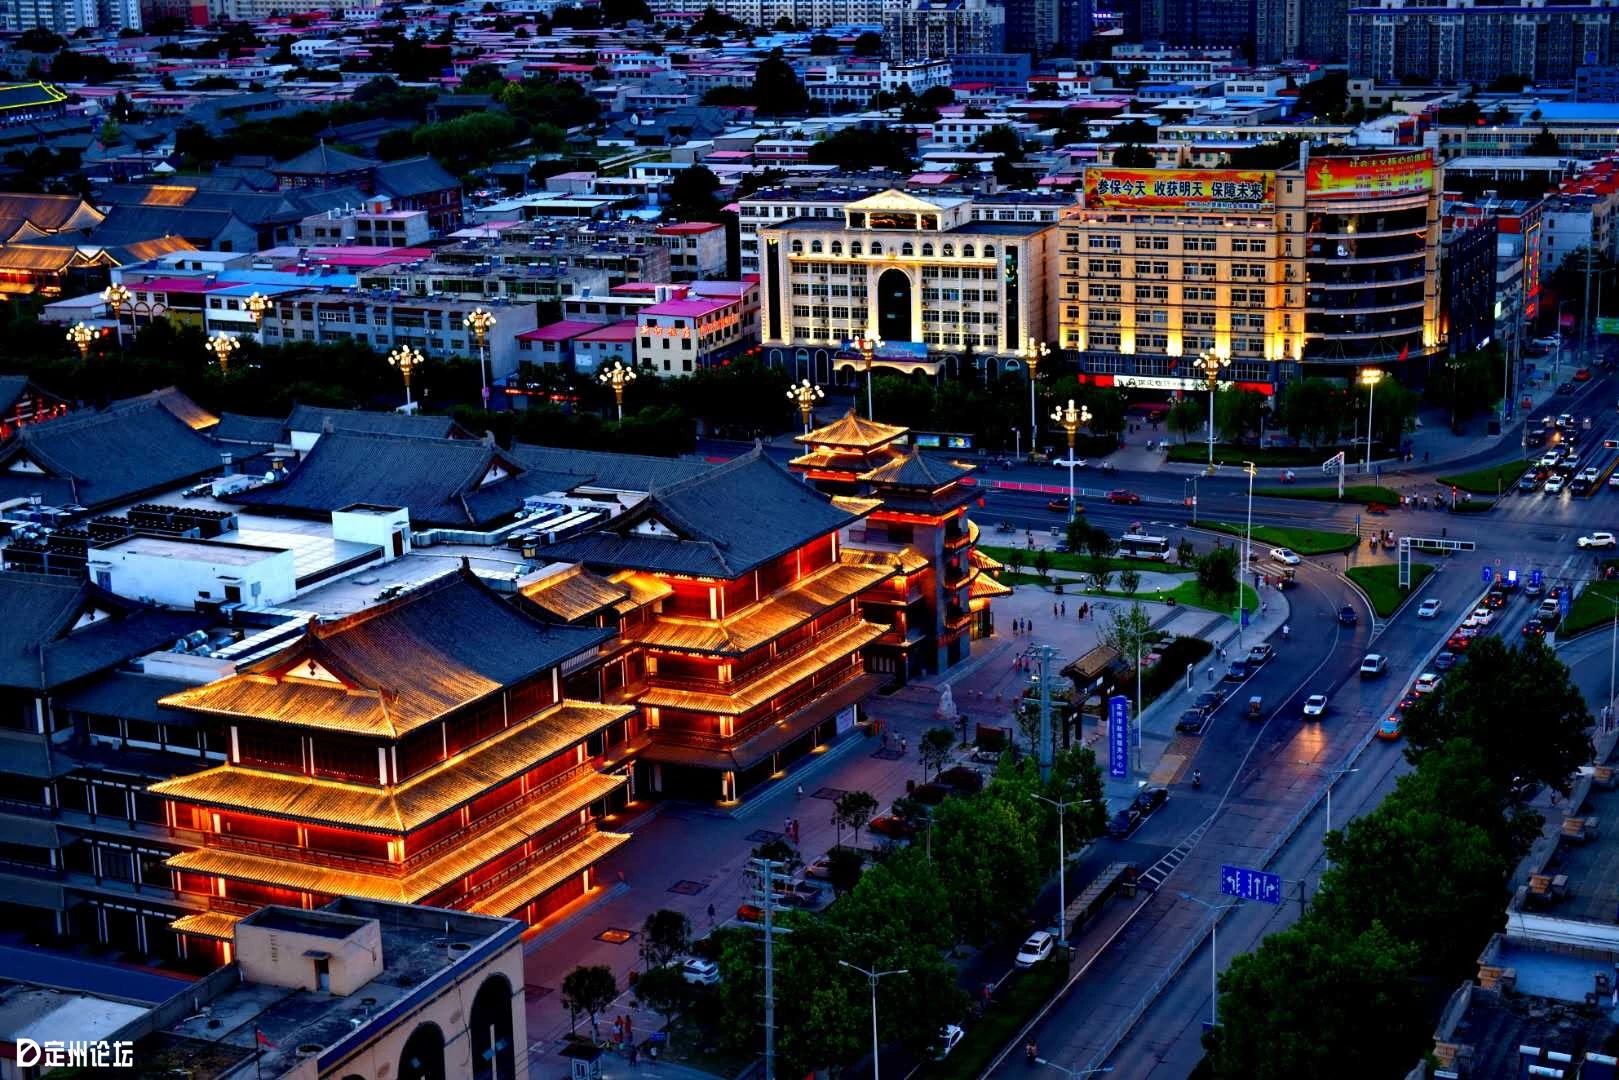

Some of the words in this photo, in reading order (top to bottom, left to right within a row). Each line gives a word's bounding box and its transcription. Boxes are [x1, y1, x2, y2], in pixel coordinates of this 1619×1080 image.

[1098, 179, 1146, 196] 参保今天
[1154, 181, 1203, 197] 收获明天
[1211, 182, 1264, 199] 保障未来
